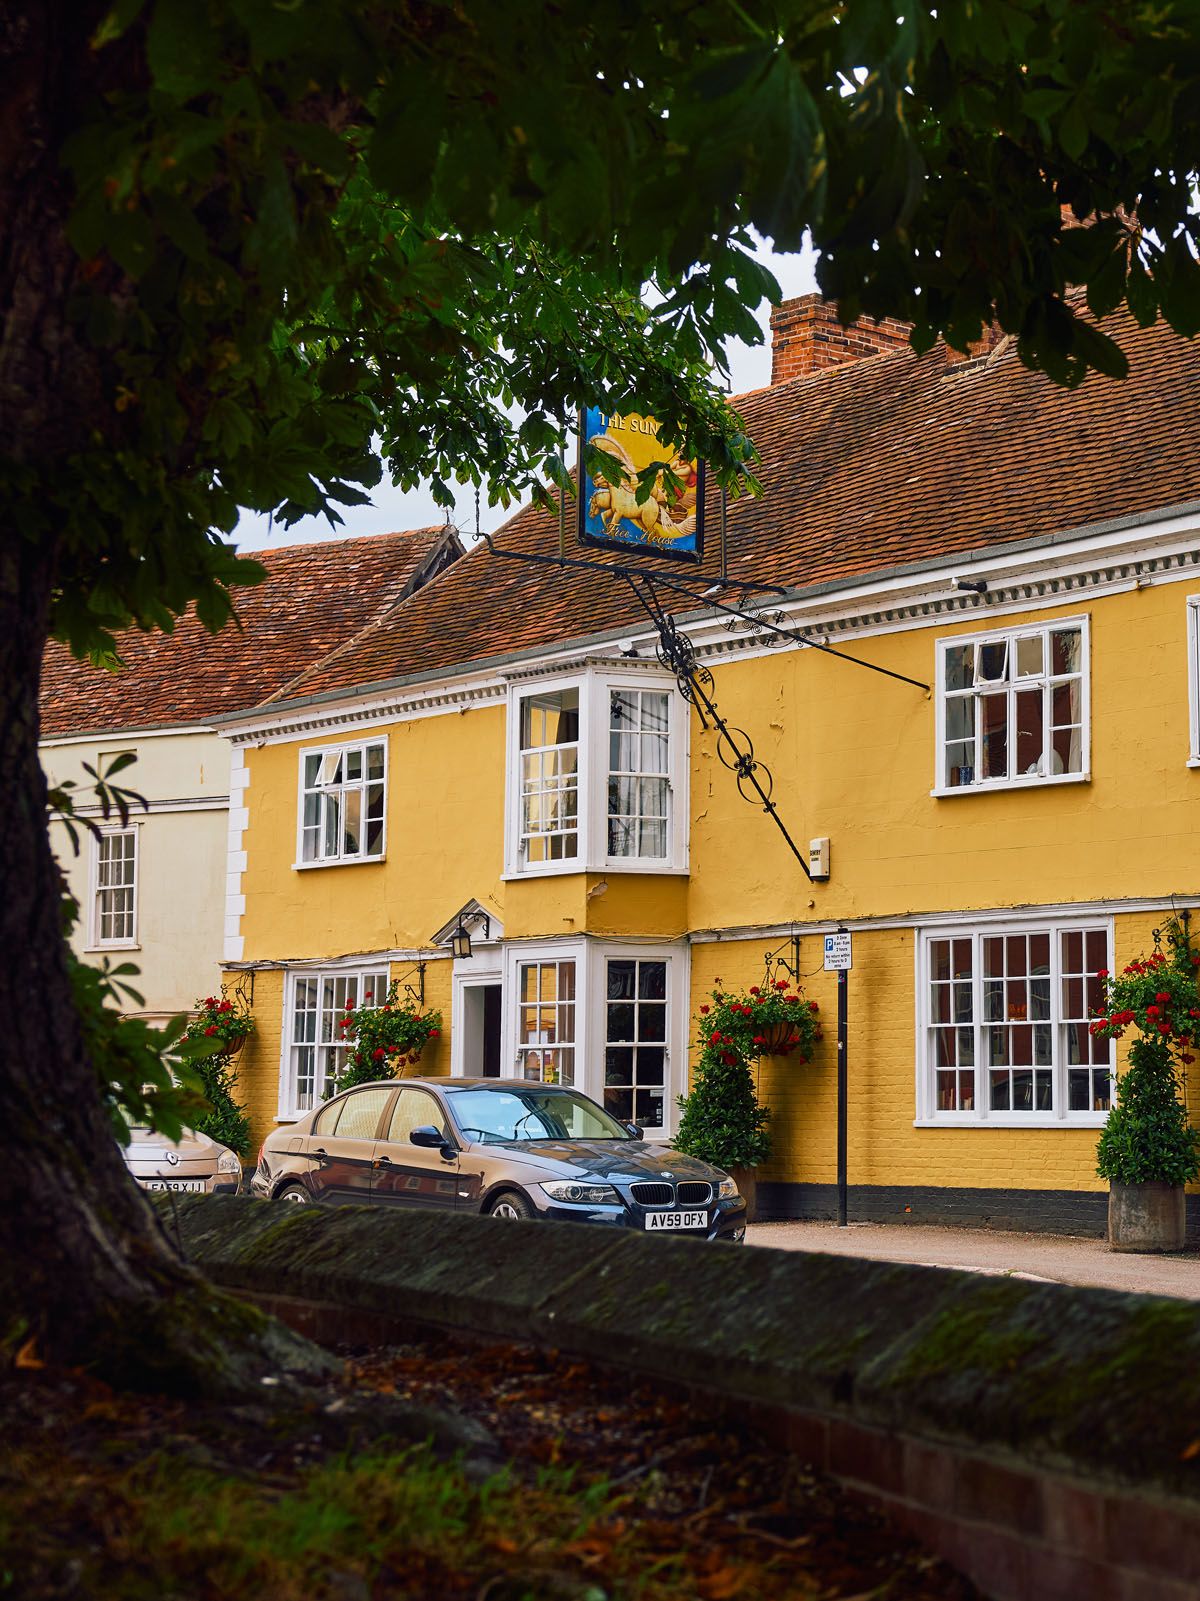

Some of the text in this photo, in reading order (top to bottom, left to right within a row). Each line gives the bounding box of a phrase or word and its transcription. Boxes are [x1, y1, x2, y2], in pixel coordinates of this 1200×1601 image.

[598, 412, 658, 435] THE SUN
[602, 523, 676, 545] Free House
[827, 939, 832, 950] P
[651, 1213, 704, 1227] AV59 OFX
